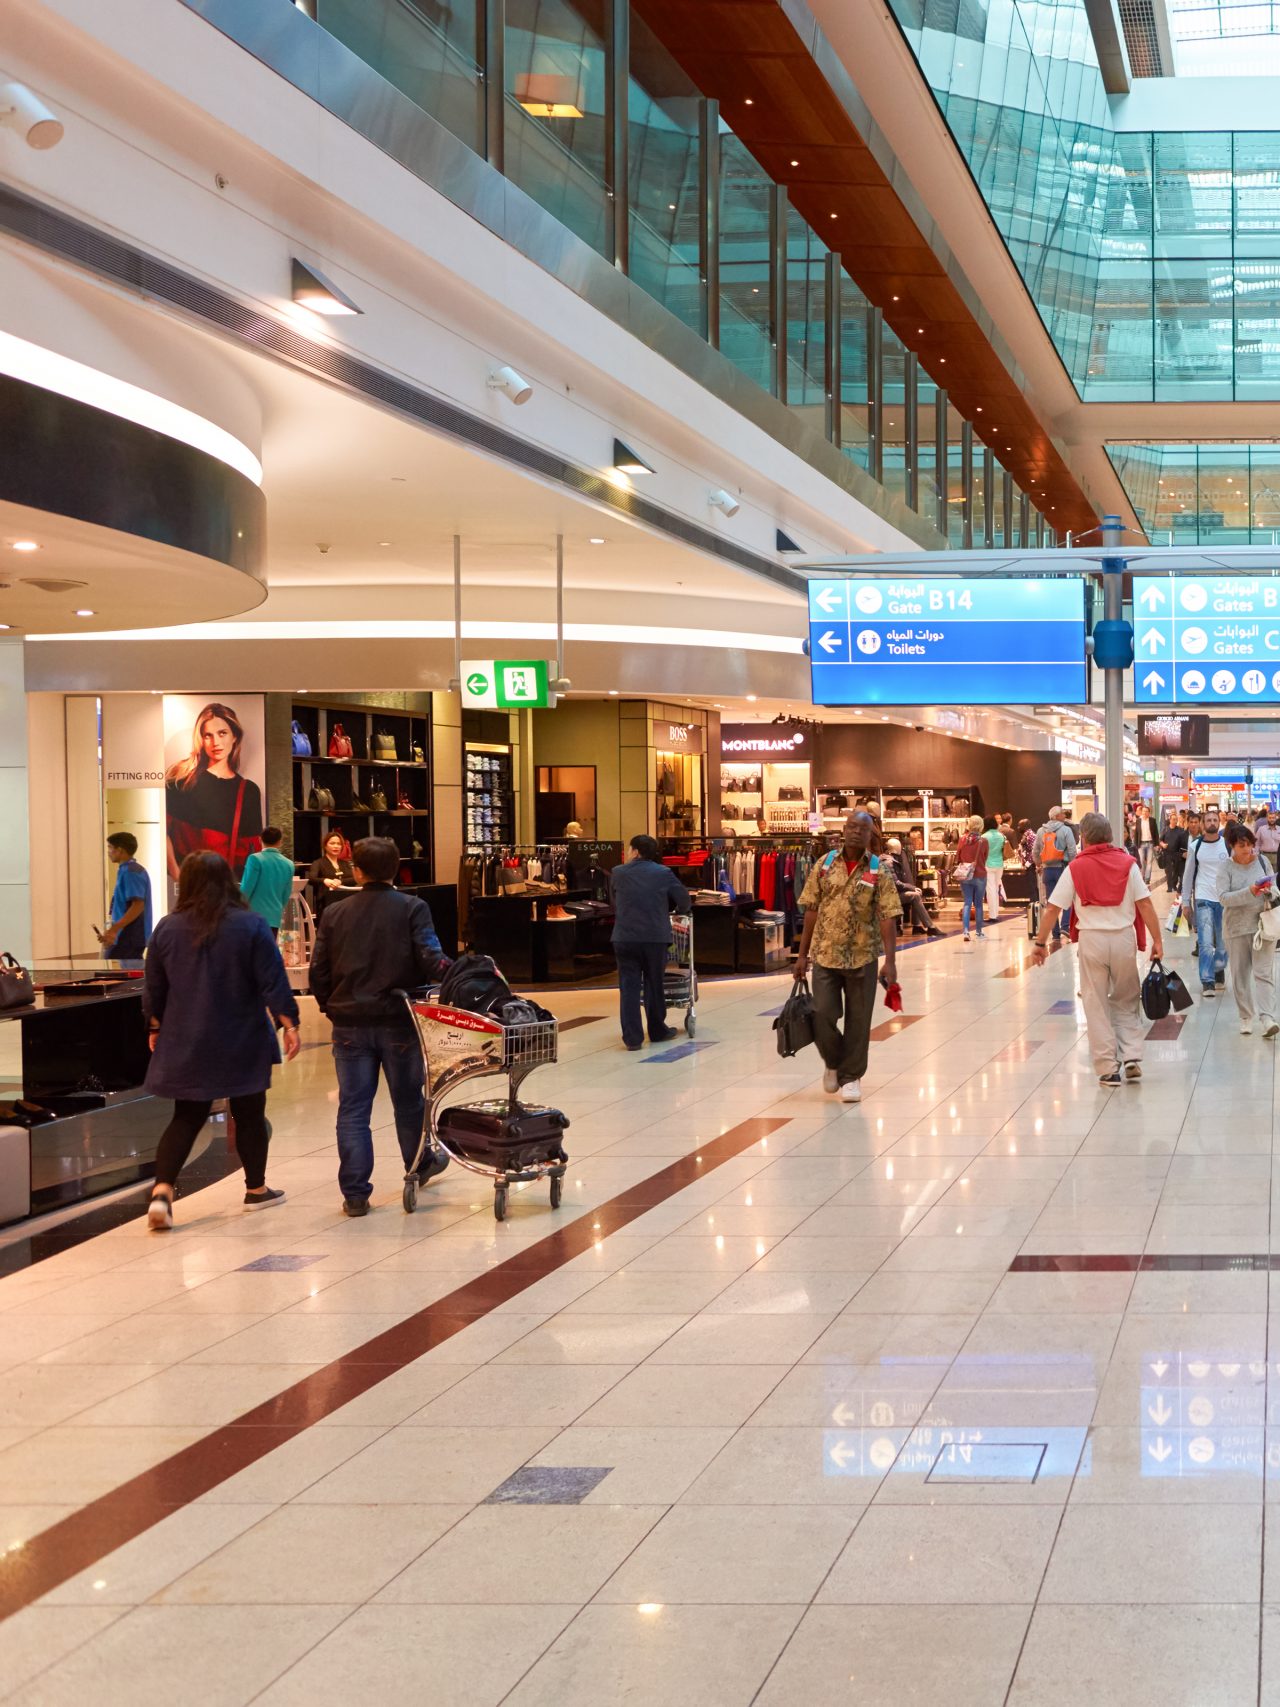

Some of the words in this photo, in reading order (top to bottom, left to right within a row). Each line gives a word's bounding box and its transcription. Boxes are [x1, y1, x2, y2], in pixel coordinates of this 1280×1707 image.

[888, 601, 922, 614] Gate
[929, 589, 973, 611] B14
[1213, 599, 1254, 612] Gates
[886, 629, 913, 642] المياه
[915, 629, 945, 642] دورات
[886, 643, 926, 655] Toilets
[1213, 642, 1254, 654] Gates
[669, 725, 688, 742] BOSS
[722, 739, 795, 751] MONTBLANC
[107, 772, 143, 780] FITTING
[144, 772, 164, 780] ROO
